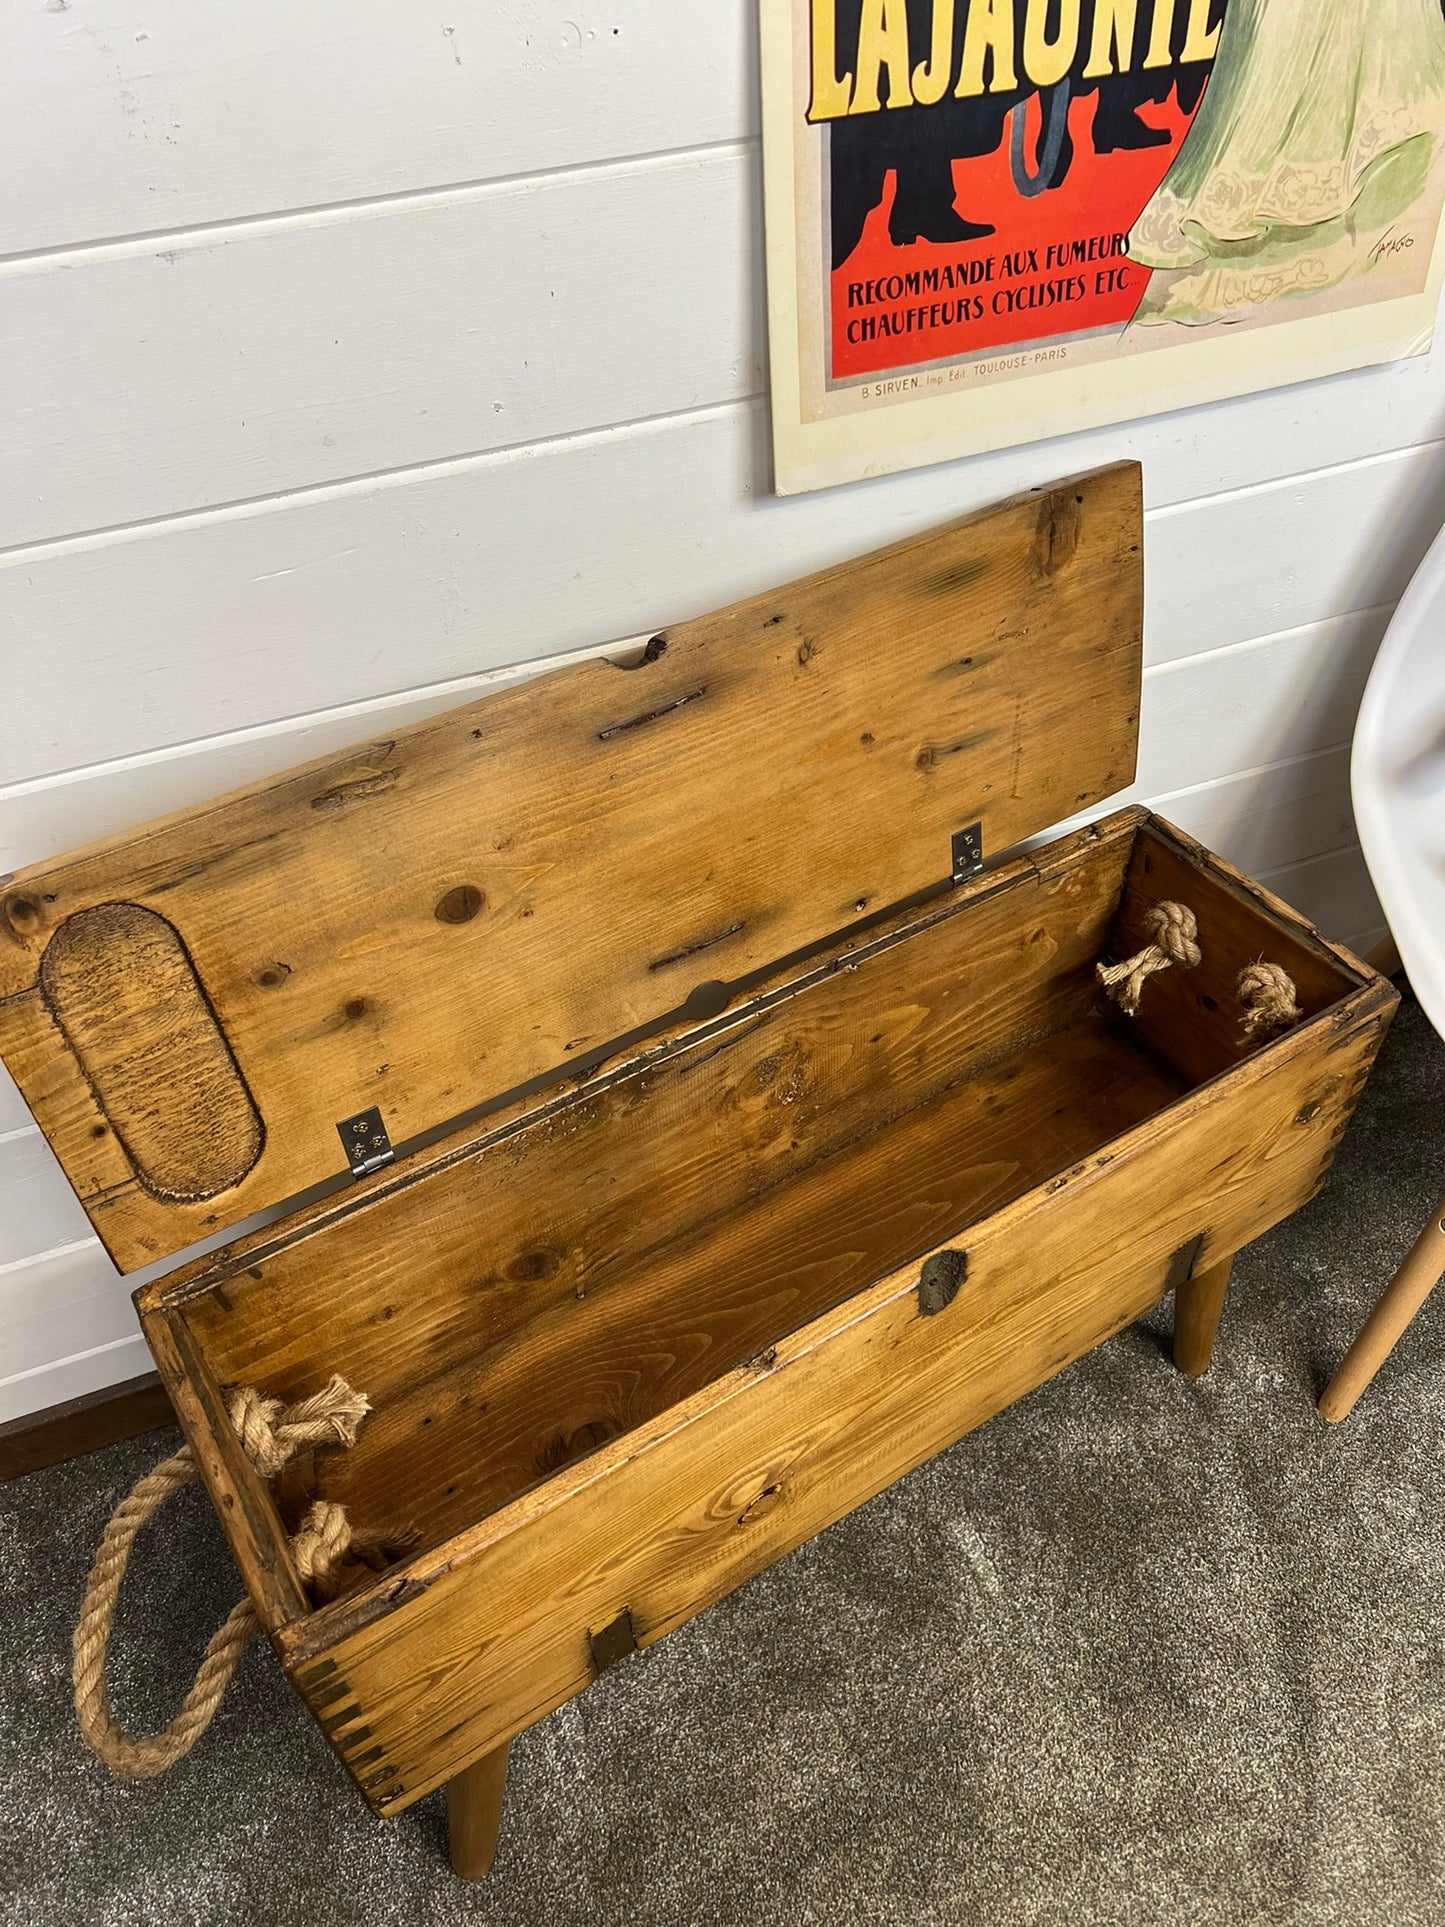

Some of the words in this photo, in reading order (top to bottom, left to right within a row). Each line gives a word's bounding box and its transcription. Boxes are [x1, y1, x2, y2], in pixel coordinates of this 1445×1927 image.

[999, 248, 1039, 279] AUX
[1046, 231, 1131, 270] FUMEURS
[847, 295, 984, 344] CHAUFFEURS
[992, 274, 1086, 315] CYCLISTES
[973, 347, 1067, 375] TOULOUSE-PARIS
